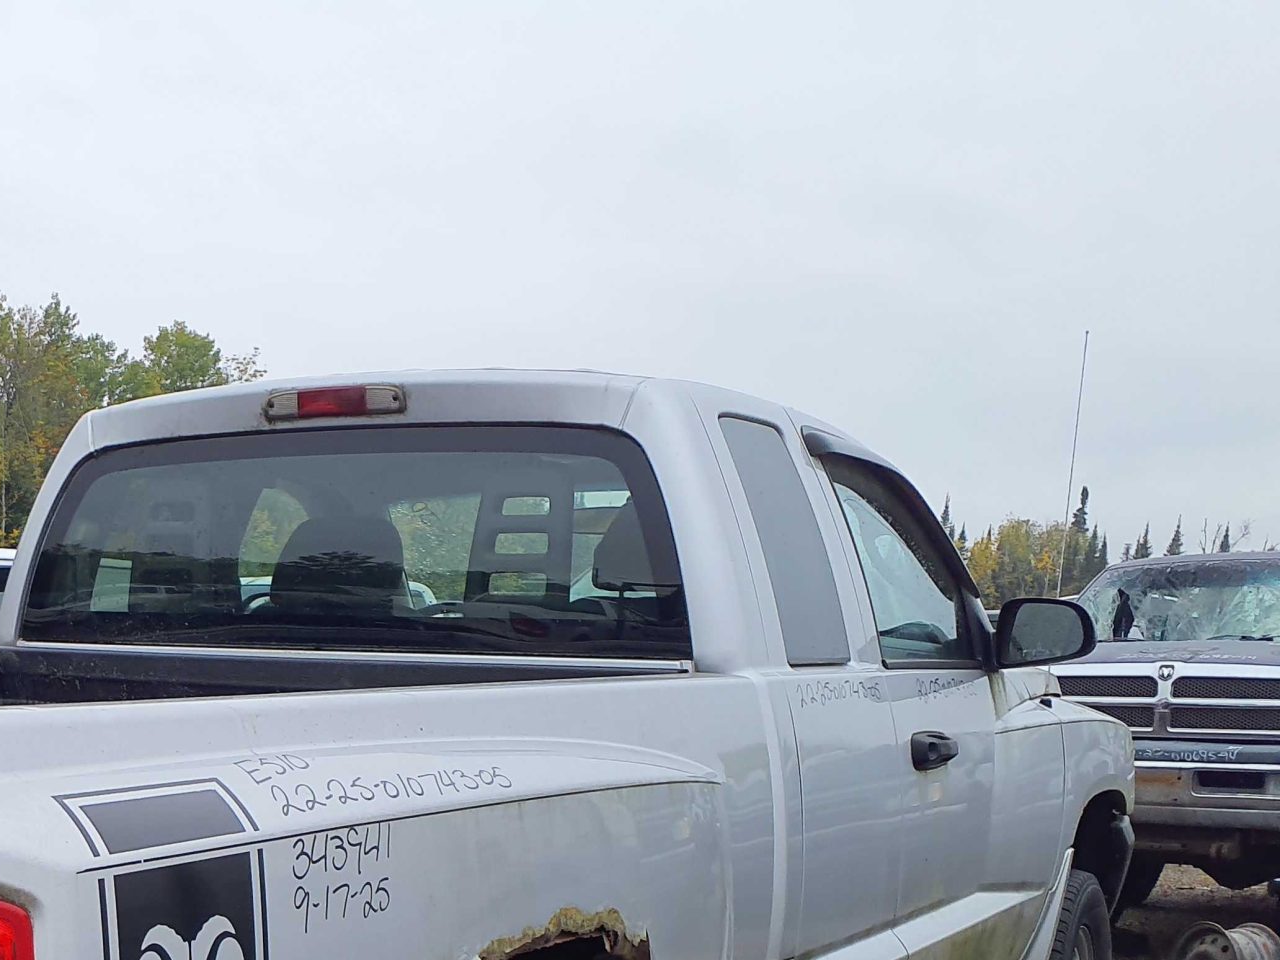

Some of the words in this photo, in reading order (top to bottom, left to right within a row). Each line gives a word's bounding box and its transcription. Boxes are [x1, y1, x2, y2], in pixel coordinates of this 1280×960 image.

[233, 754, 311, 785] E510
[270, 766, 513, 817] 22-25-010743-05
[292, 821, 392, 881] 343941
[293, 877, 391, 934] 9-17-25
